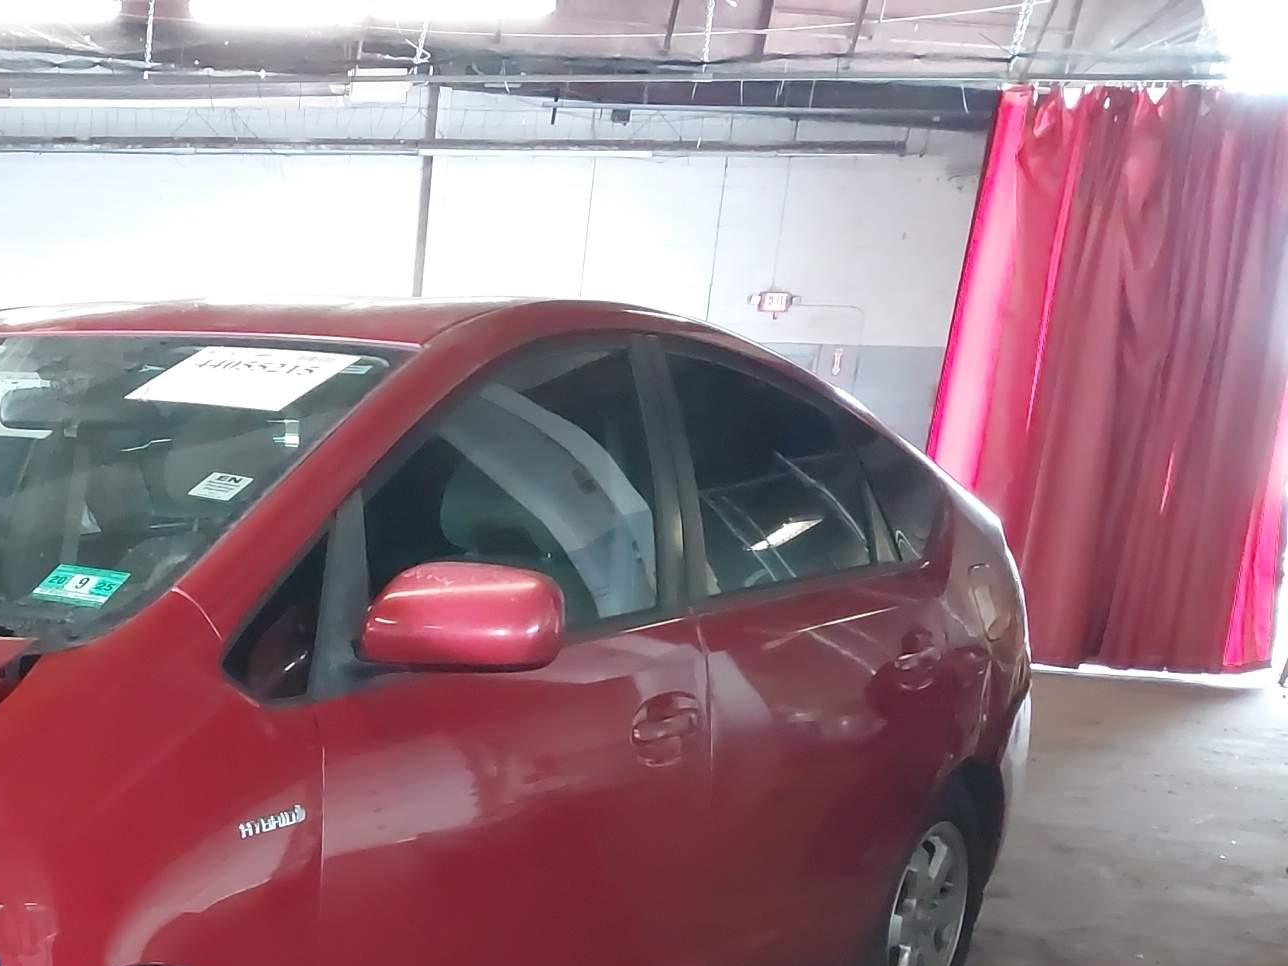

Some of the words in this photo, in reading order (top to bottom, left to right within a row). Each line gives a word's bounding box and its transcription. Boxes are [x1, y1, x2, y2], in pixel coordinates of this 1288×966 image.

[48, 575, 68, 585] 20
[75, 577, 91, 590] 9
[94, 582, 117, 592] 25
